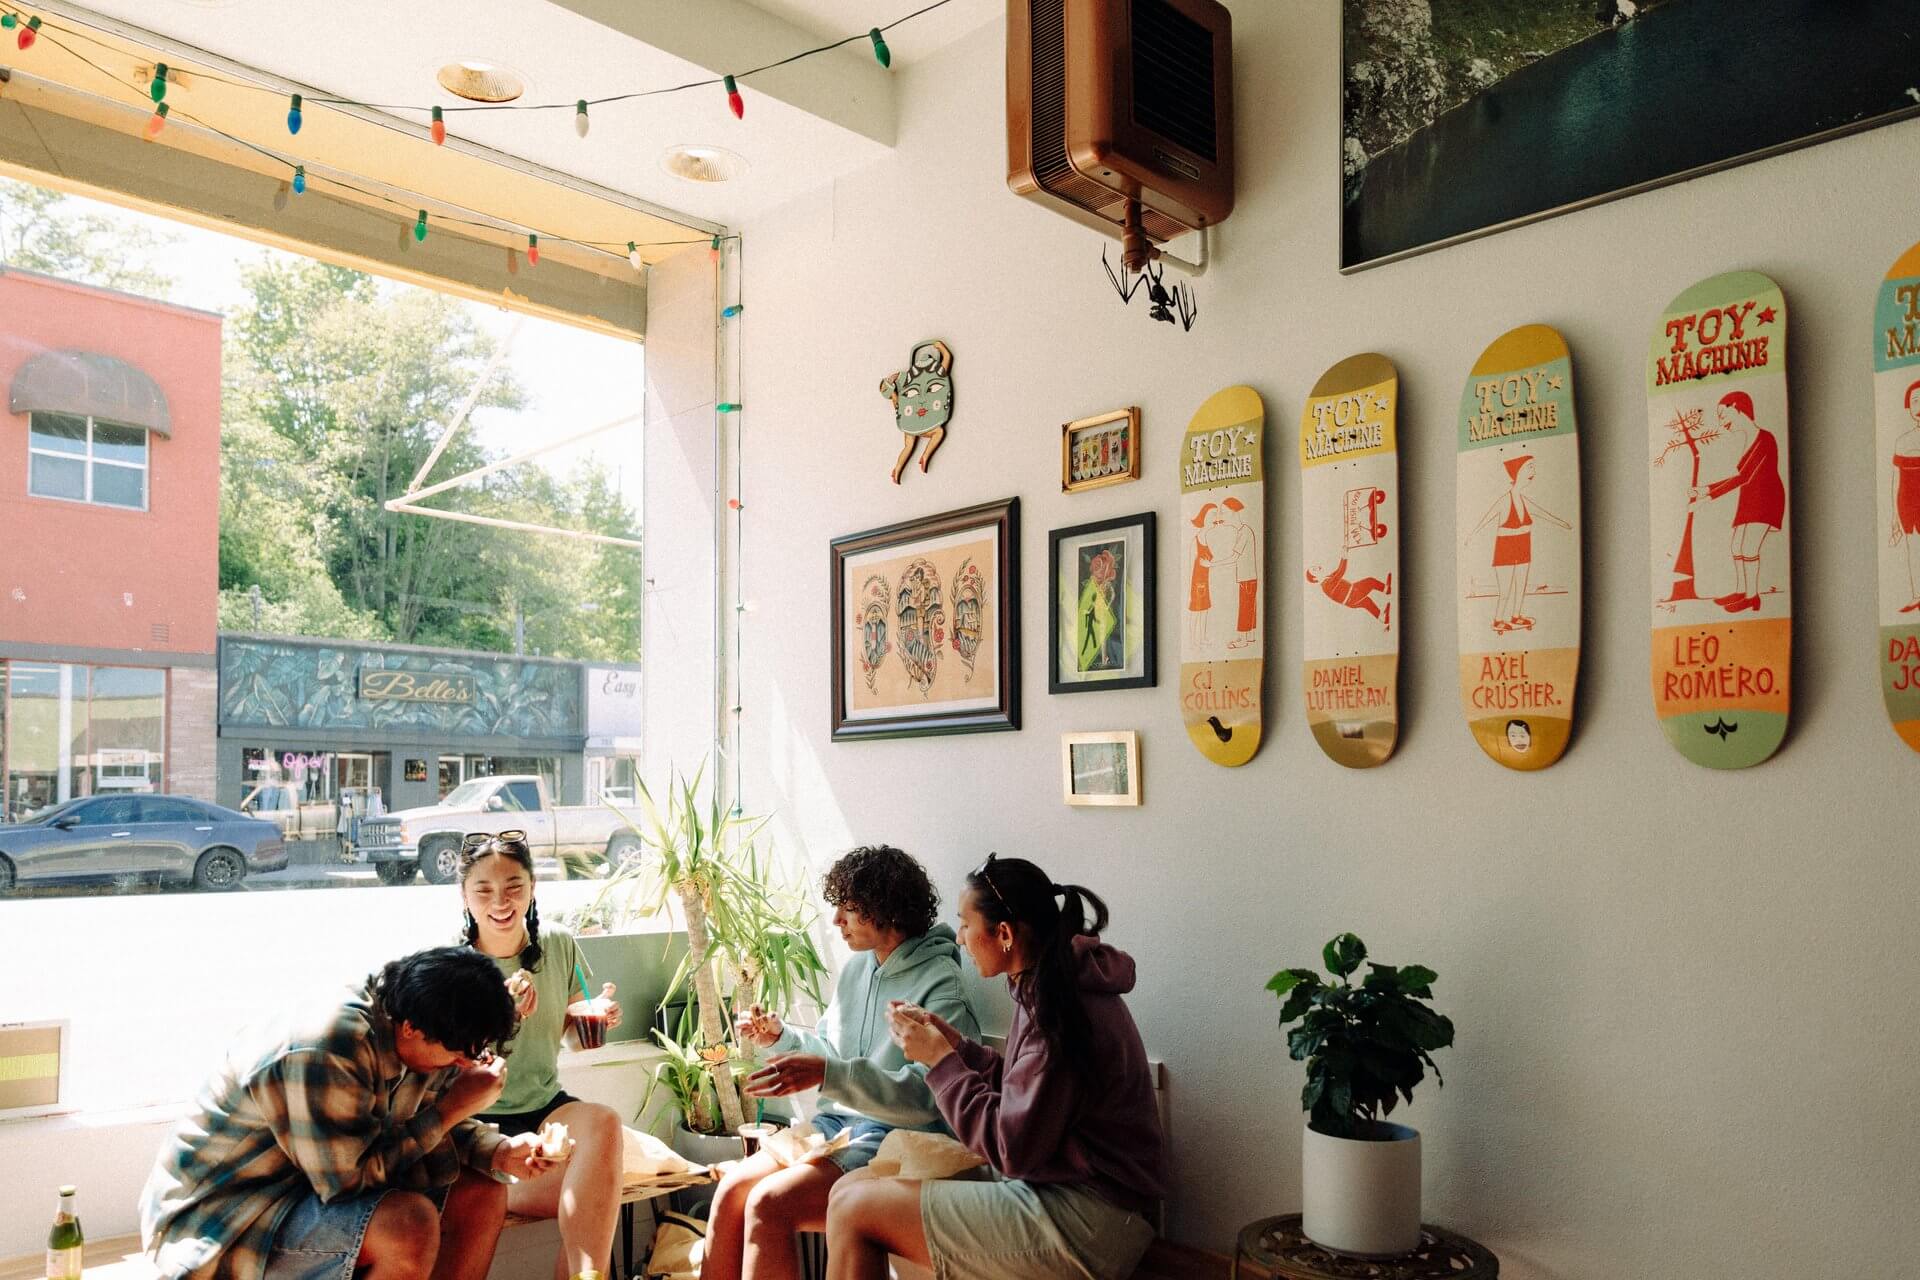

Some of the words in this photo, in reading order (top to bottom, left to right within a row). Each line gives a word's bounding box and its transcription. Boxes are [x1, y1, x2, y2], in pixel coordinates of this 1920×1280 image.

[1666, 301, 1757, 353] TOY
[1656, 337, 1769, 386] MACHINE
[1474, 369, 1548, 414] TOY
[1312, 391, 1376, 433] TOY
[1468, 401, 1558, 442] MACHINE
[1190, 427, 1244, 462] TOY
[1305, 422, 1383, 459] MACHINE
[1184, 454, 1252, 487] MACHINE
[1675, 635, 1719, 666] LEO
[1313, 665, 1364, 688] DANIEL
[1481, 654, 1528, 681] AXEL
[1664, 666, 1780, 701] ROMERO.
[363, 671, 472, 700] Belle's
[602, 671, 636, 698] Easy
[1184, 687, 1256, 710] COLLINS.
[1307, 686, 1391, 711] LUTHERAN.
[1472, 682, 1562, 709] CRUSHER.
